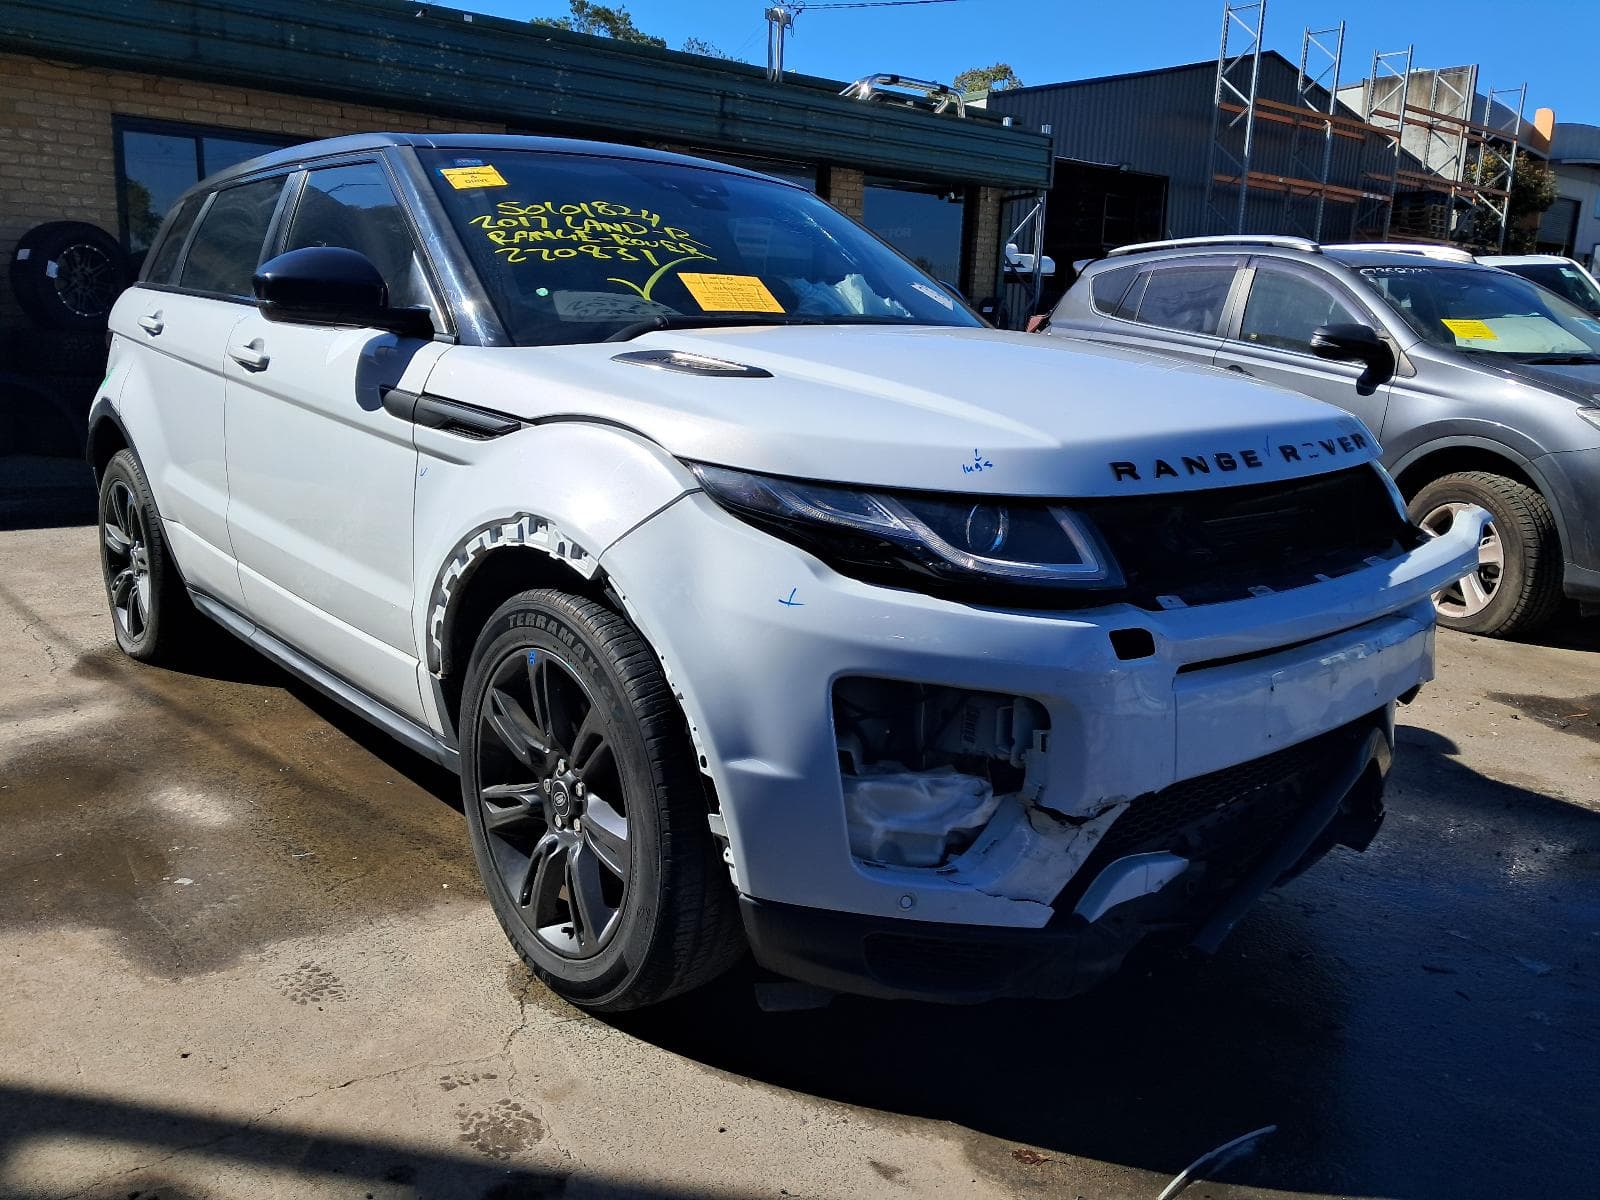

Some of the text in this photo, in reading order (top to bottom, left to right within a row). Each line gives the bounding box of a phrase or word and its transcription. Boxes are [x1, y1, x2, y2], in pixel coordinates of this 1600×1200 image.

[469, 215, 549, 229] 2017
[494, 245, 660, 267] 220831
[1108, 449, 1263, 482] RANGE
[508, 612, 599, 675] TERRAMAX
